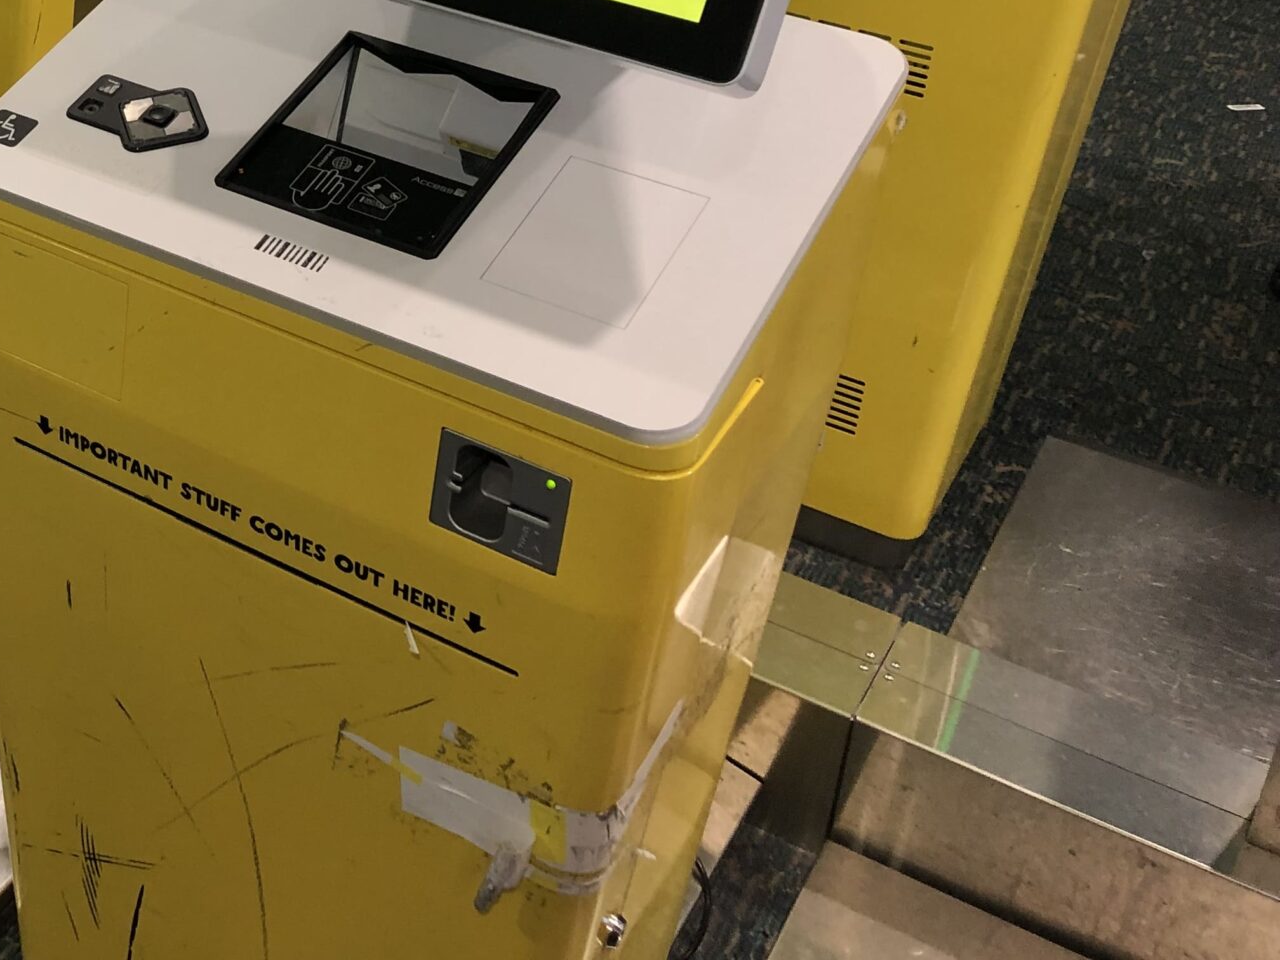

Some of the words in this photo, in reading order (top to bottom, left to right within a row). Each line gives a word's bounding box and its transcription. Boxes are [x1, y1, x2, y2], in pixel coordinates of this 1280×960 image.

[58, 425, 173, 490] IMPORTANT
[180, 482, 242, 523] STUFF
[249, 515, 326, 562] COMES
[333, 554, 385, 588] OUT
[392, 578, 456, 623] HERE!
